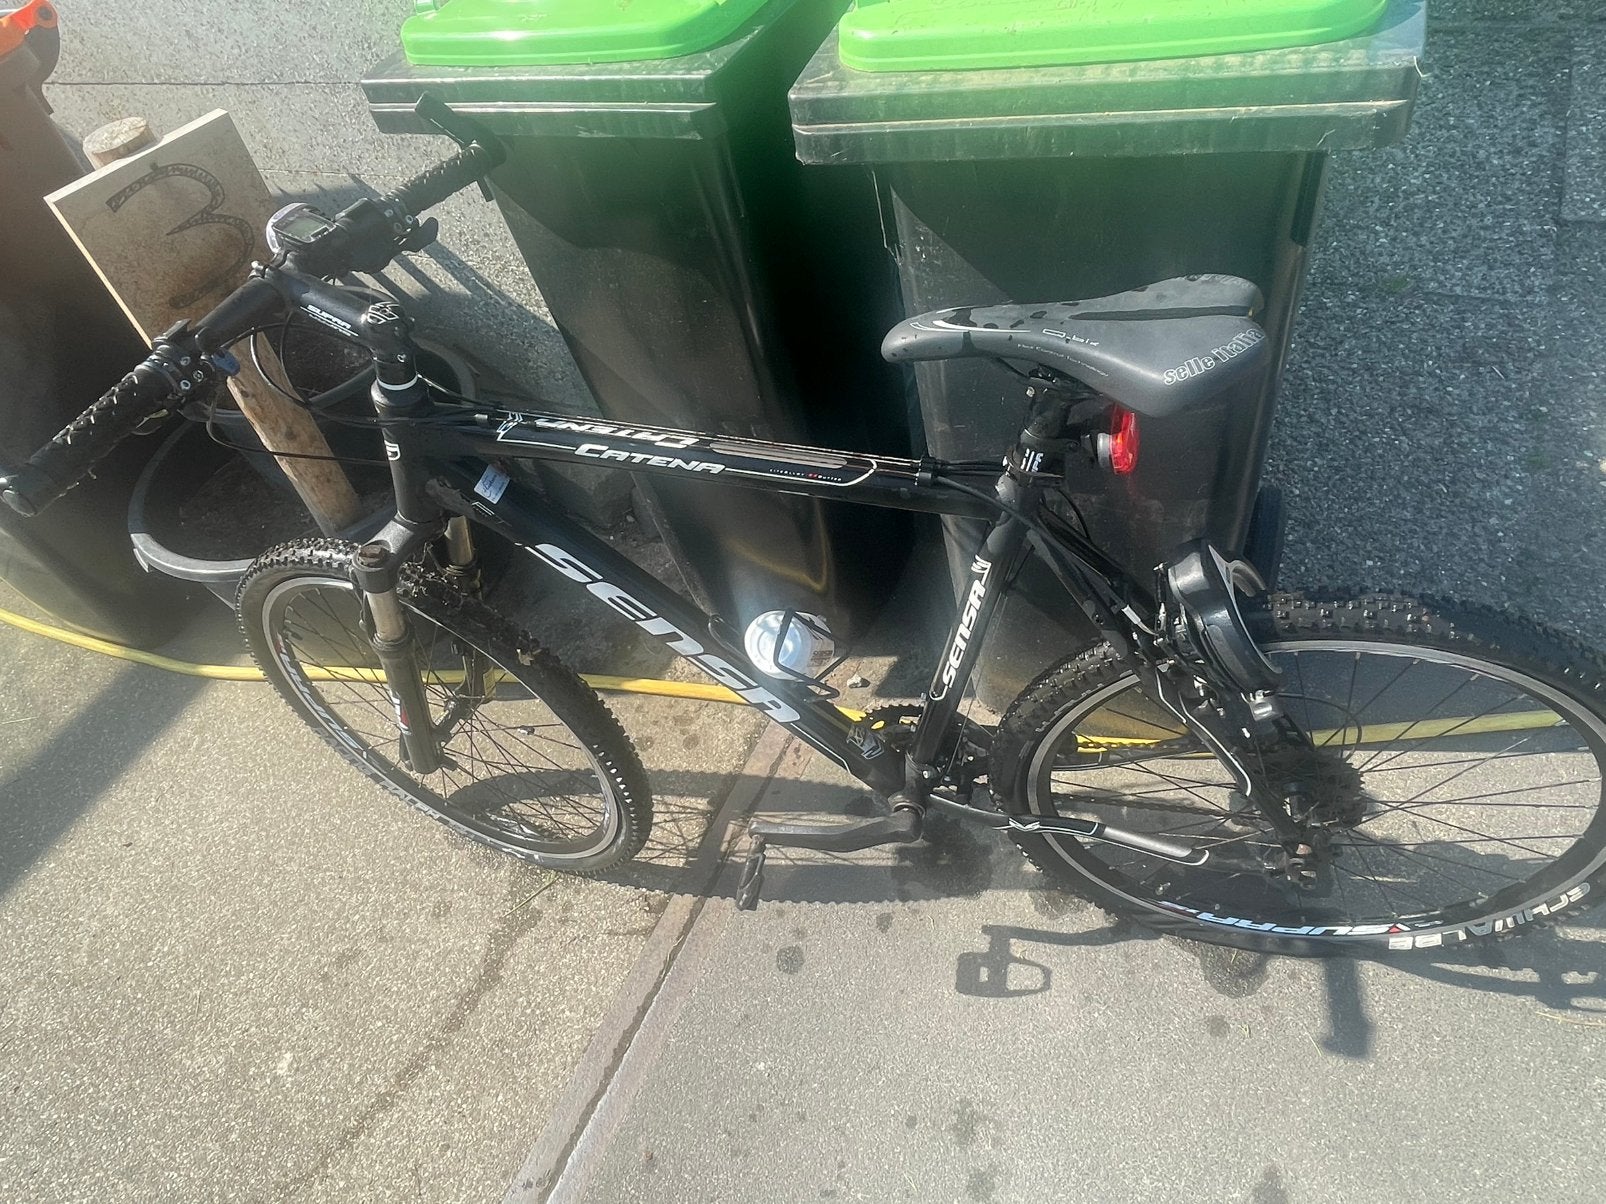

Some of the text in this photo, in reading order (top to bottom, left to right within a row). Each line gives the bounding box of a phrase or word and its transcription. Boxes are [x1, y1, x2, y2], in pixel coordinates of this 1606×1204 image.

[105, 161, 255, 309] 3
[1163, 327, 1266, 386] selle italia
[574, 442, 727, 475] CATENA
[534, 542, 801, 724] SENSA
[942, 579, 986, 689] SENSA
[1196, 911, 1396, 937] SUPRA
[1388, 881, 1591, 951] SCHWALBE
